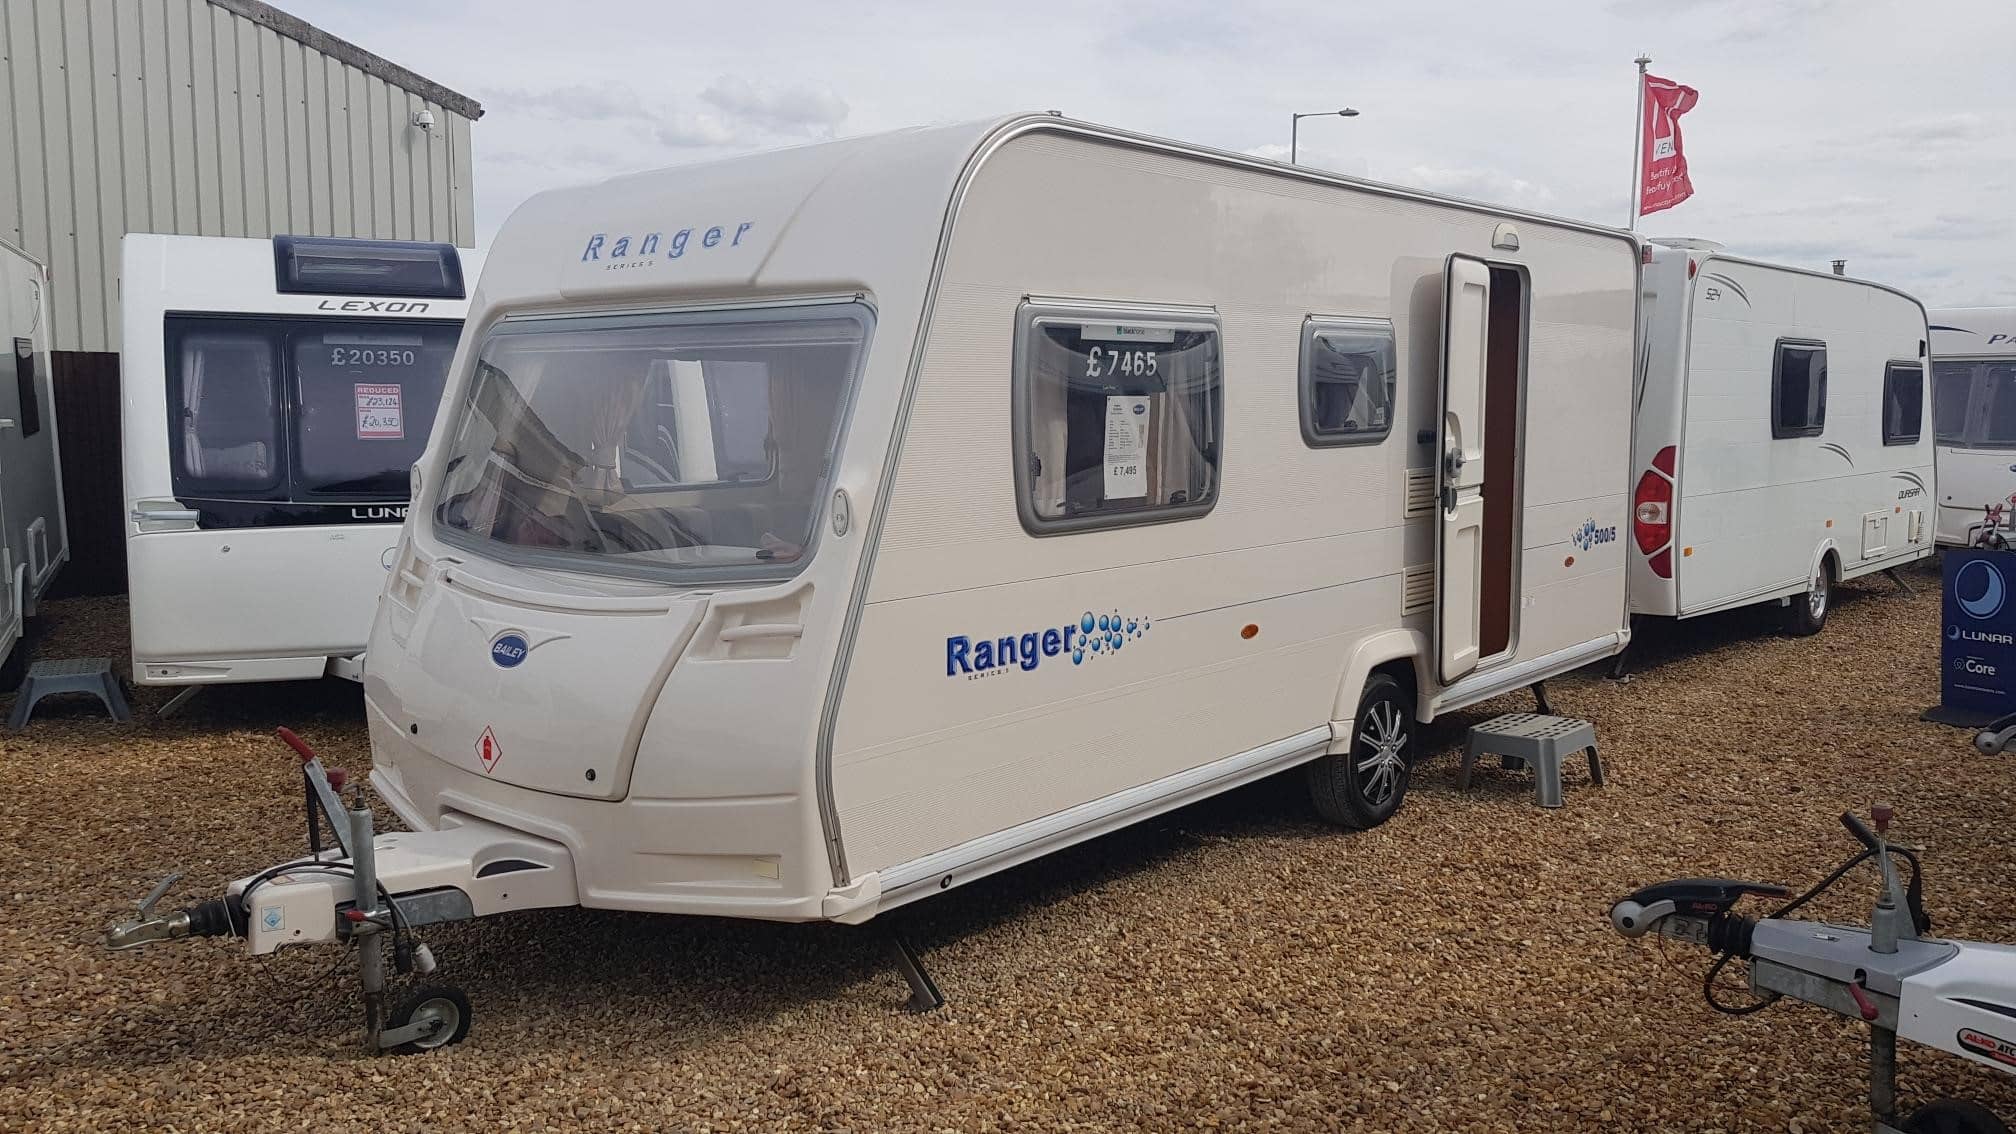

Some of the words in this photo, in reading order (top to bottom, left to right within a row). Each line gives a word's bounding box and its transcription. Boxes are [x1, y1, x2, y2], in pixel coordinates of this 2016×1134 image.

[581, 221, 754, 263] Ranger
[318, 300, 430, 313] LEXON
[331, 348, 415, 366] £20350
[1594, 526, 1616, 544] 500/5
[1962, 630, 2013, 645] LUNAR
[493, 642, 526, 659] BAILEY
[946, 624, 1078, 677] Ranger
[1966, 660, 1995, 675] Core
